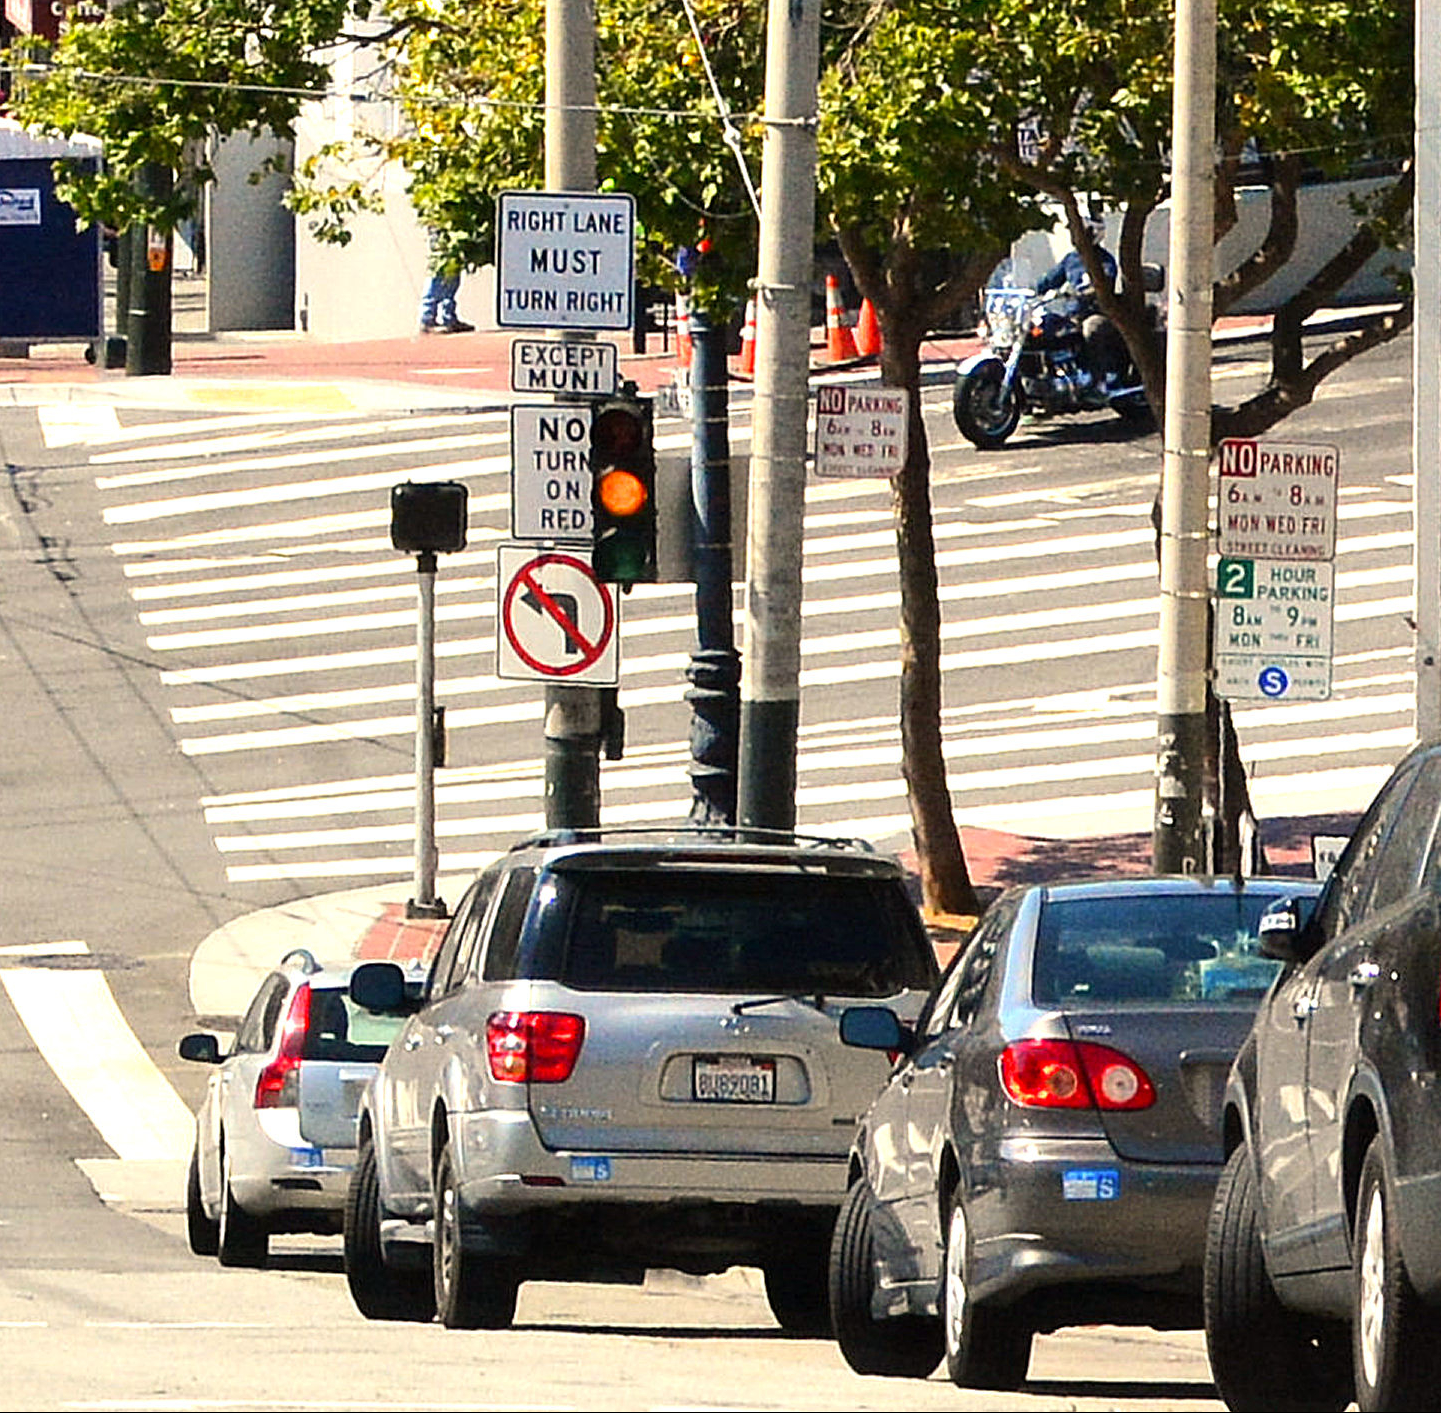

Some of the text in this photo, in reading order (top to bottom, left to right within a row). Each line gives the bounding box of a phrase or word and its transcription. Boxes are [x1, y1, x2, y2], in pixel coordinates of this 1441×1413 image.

[507, 210, 626, 235] RIGHT LANE
[530, 248, 603, 276] MUST
[504, 288, 626, 314] TURN RIGHT
[520, 345, 607, 368] EXCEPT
[528, 368, 601, 391] MUNI
[819, 387, 904, 414] NO PARKING
[538, 417, 586, 443] NO
[533, 450, 591, 472] TURN
[1222, 444, 1335, 477] NO PARKING
[546, 479, 580, 501] ON
[541, 508, 587, 530] RED
[1227, 515, 1325, 535] MON WED FRI
[1227, 541, 1269, 554] STREET
[1225, 562, 1316, 593] 2 HOUR
[1256, 584, 1329, 602] PARKING
[1229, 633, 1262, 648] MON
[1296, 634, 1320, 649] FRI
[1264, 671, 1282, 694] S
